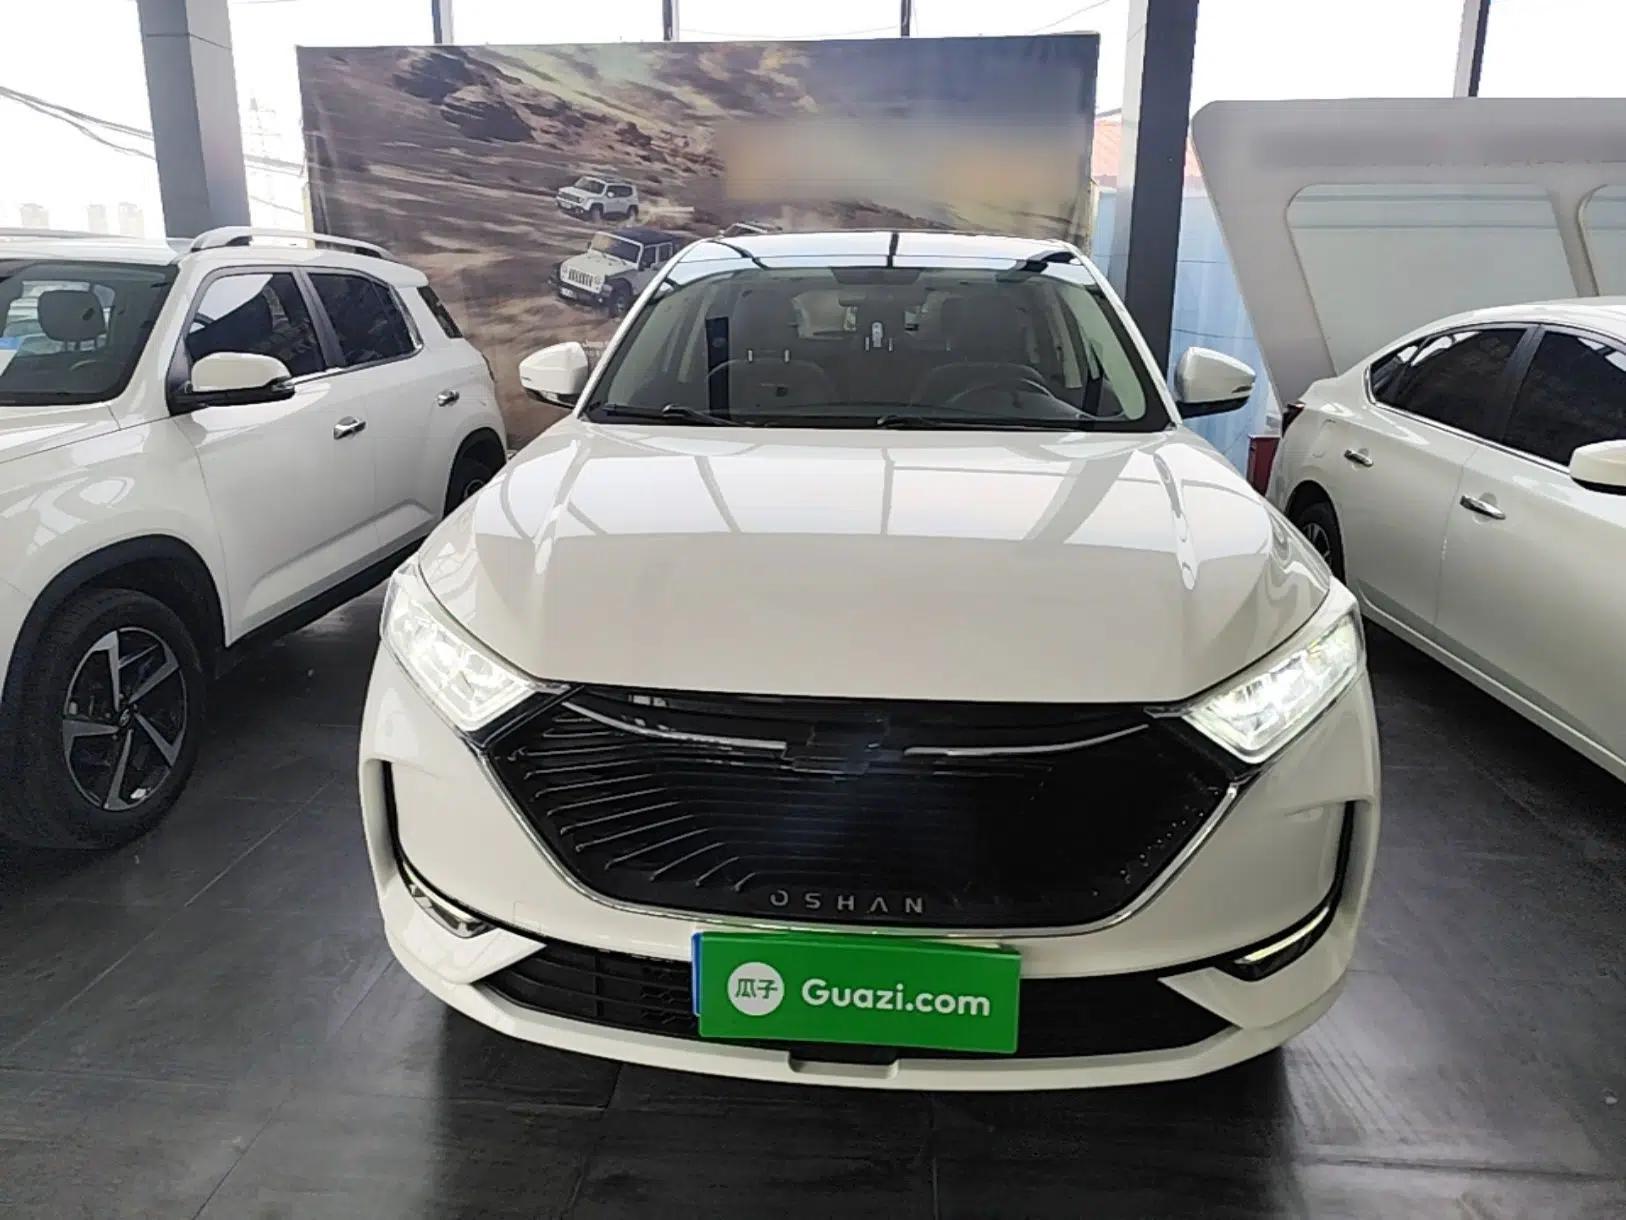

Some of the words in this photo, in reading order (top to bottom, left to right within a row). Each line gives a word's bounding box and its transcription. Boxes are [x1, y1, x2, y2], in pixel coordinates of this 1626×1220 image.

[769, 889, 923, 913] OSHAN
[734, 977, 778, 999] 瓜子
[801, 978, 991, 1017] Guazi.com
